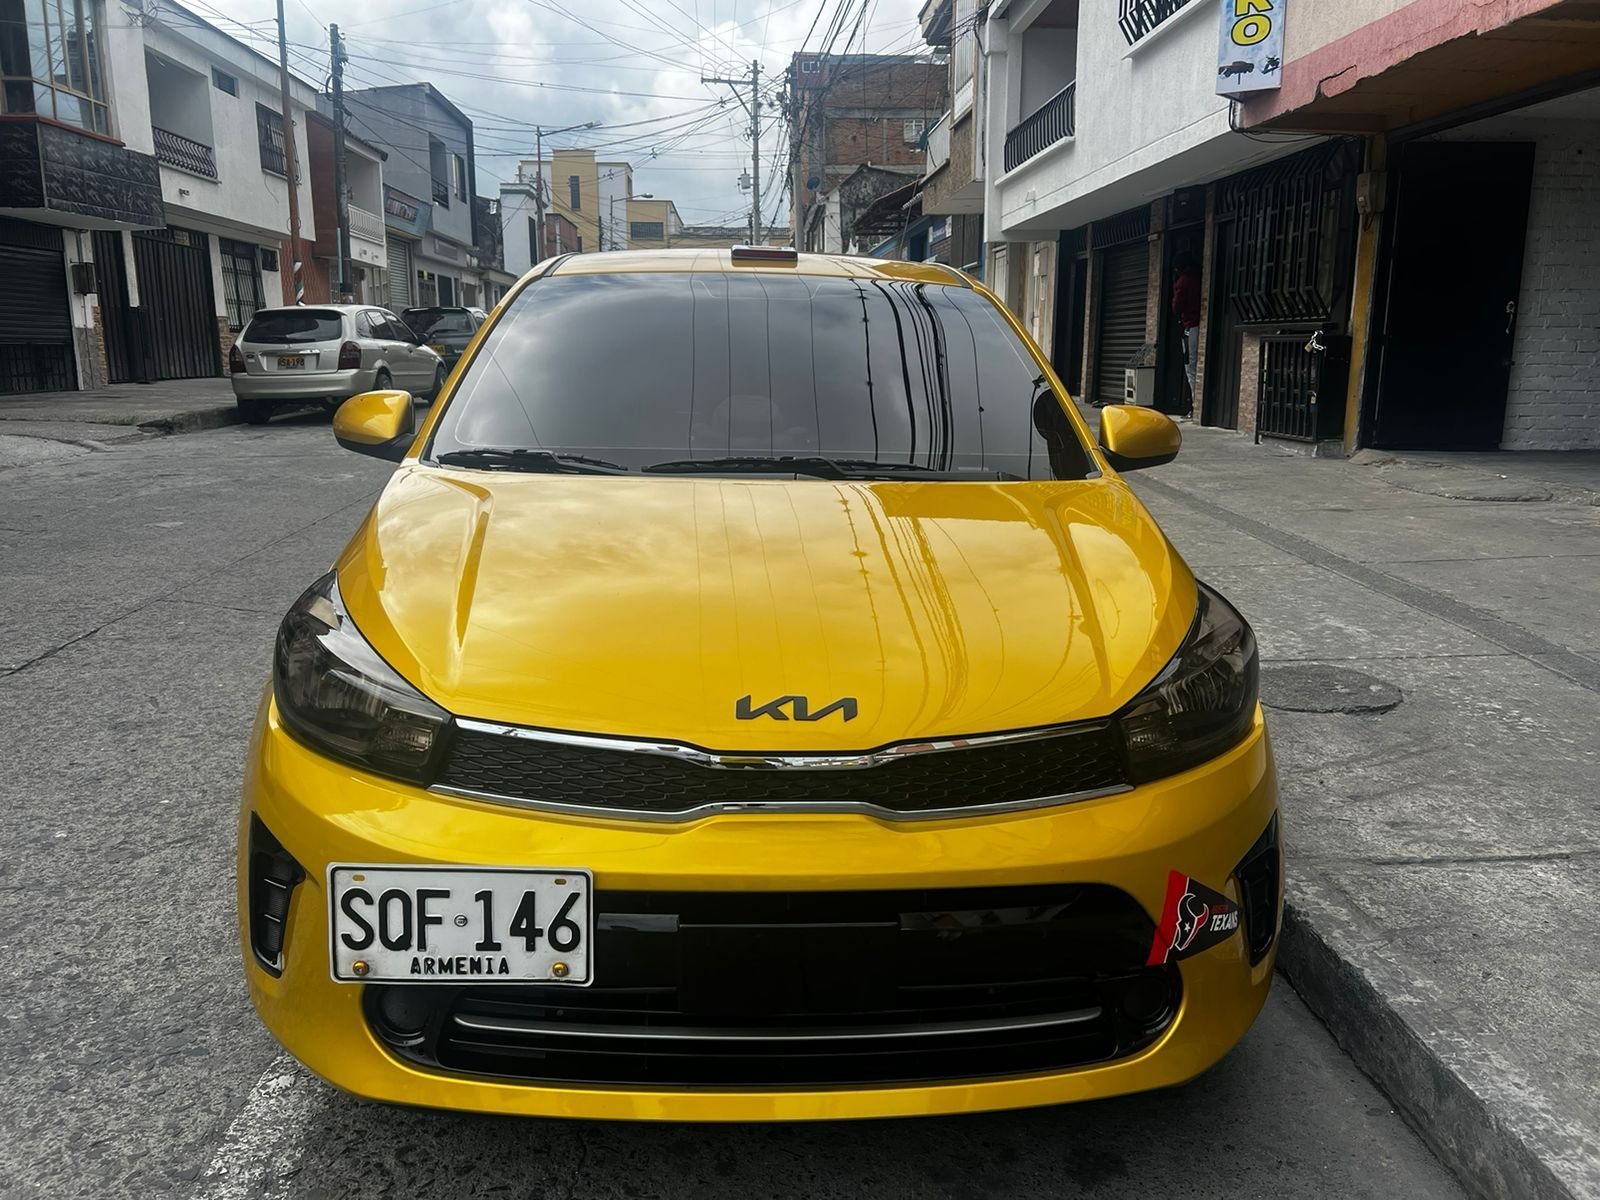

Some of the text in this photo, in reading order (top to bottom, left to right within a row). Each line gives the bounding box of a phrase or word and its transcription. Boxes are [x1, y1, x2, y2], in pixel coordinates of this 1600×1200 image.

[736, 694, 857, 722] KIA
[1209, 910, 1238, 932] TEXANS
[410, 956, 510, 975] ARMENIA
